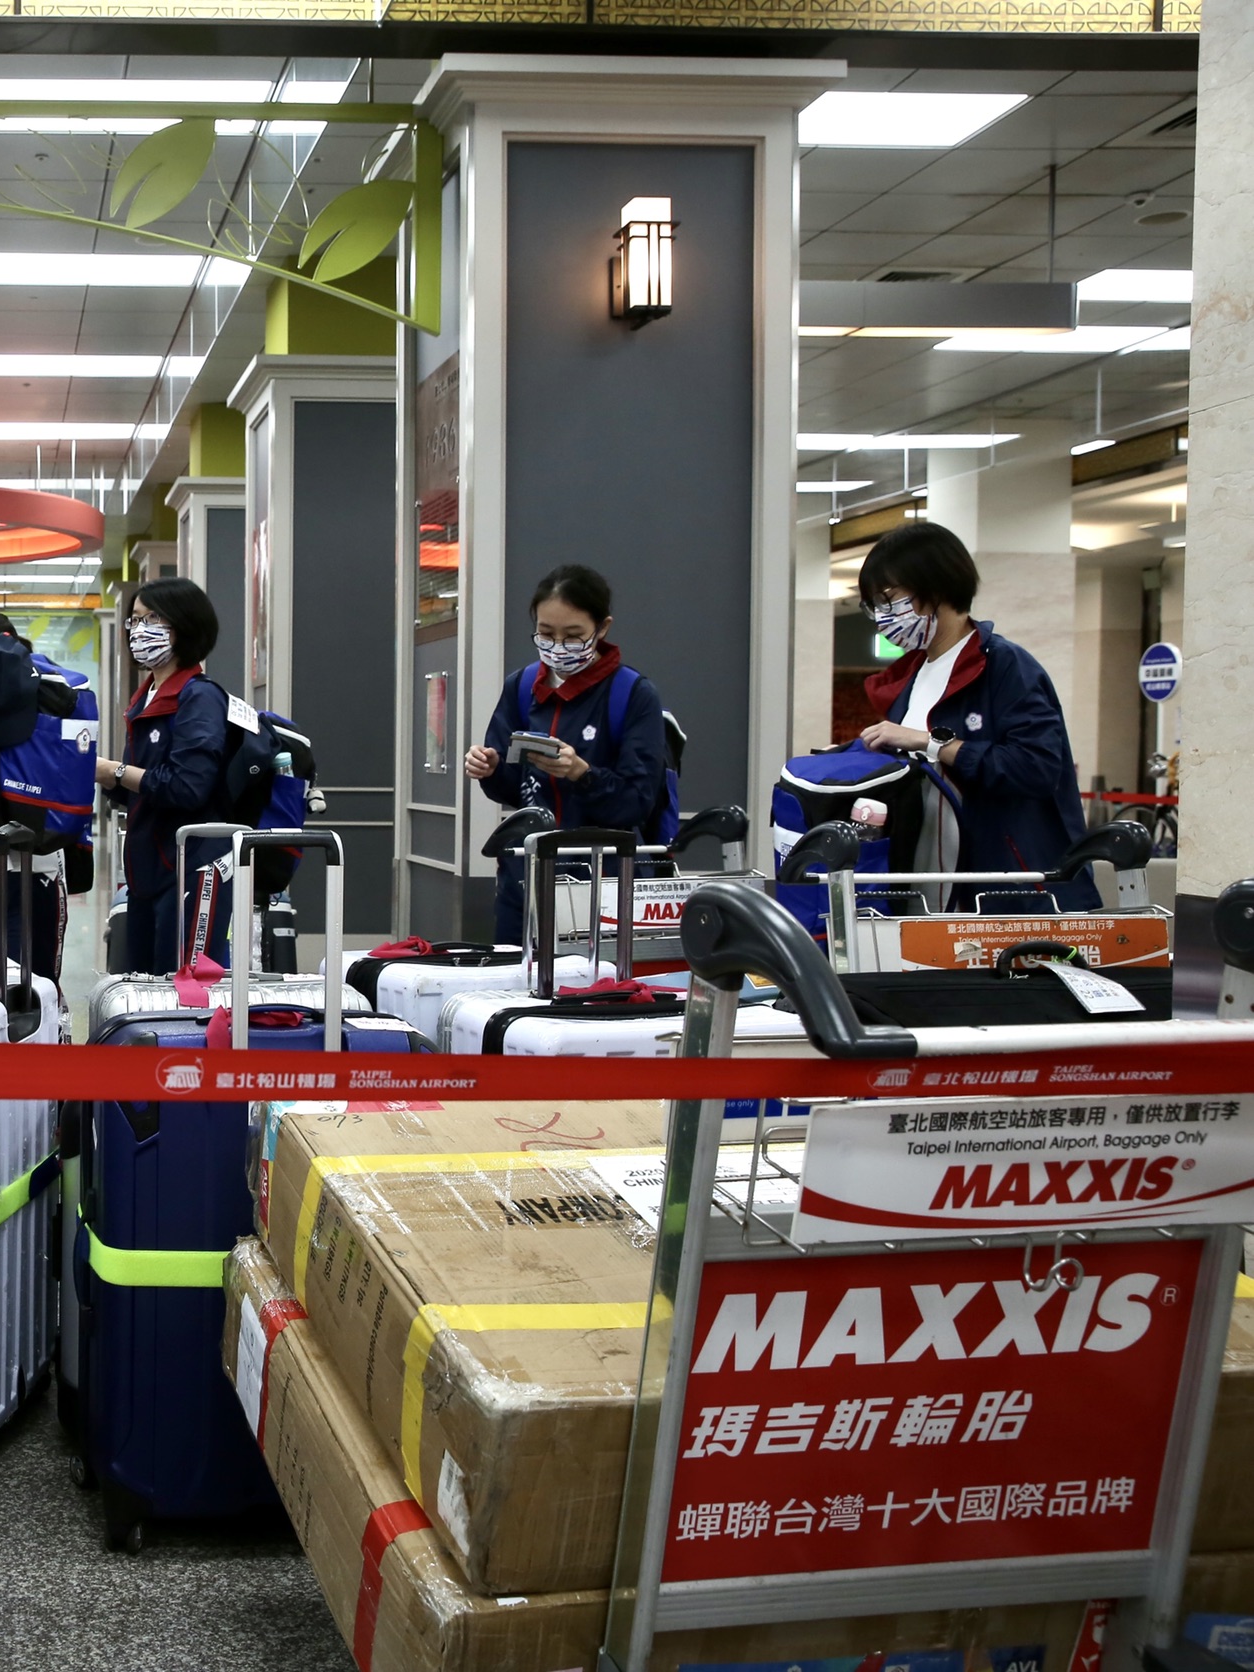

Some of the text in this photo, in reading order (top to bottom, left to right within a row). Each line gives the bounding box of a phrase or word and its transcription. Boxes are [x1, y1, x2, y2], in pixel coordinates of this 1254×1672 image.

[4, 779, 42, 794] CHINESE TAIPEI
[202, 879, 212, 901] TAIPEI
[196, 912, 208, 939] CHINESE
[1086, 933, 1103, 942] Only
[350, 1069, 392, 1079] TAIPEI
[922, 1069, 1040, 1087] 臺北松山機場
[1049, 1070, 1174, 1083] SONGSHAN AIRPORT
[1054, 1064, 1094, 1073] TAIPEI
[216, 1072, 336, 1089] 臺北松山機場
[348, 1078, 477, 1089] SONGSHAN AIRPORT
[887, 1101, 1241, 1135] 臺北國際航空站旅客專用，僅供放置行李
[906, 1130, 1208, 1157] Taipei International Airport, Baggage Only
[928, 1156, 1180, 1210] MAXXIS
[373, 1282, 389, 1330] Portable
[691, 1273, 1160, 1374] MAXXIS
[682, 1390, 1033, 1459] 瑪吉斯輪胎
[675, 1477, 1135, 1542] 蟬聯台灣十大國際品牌
